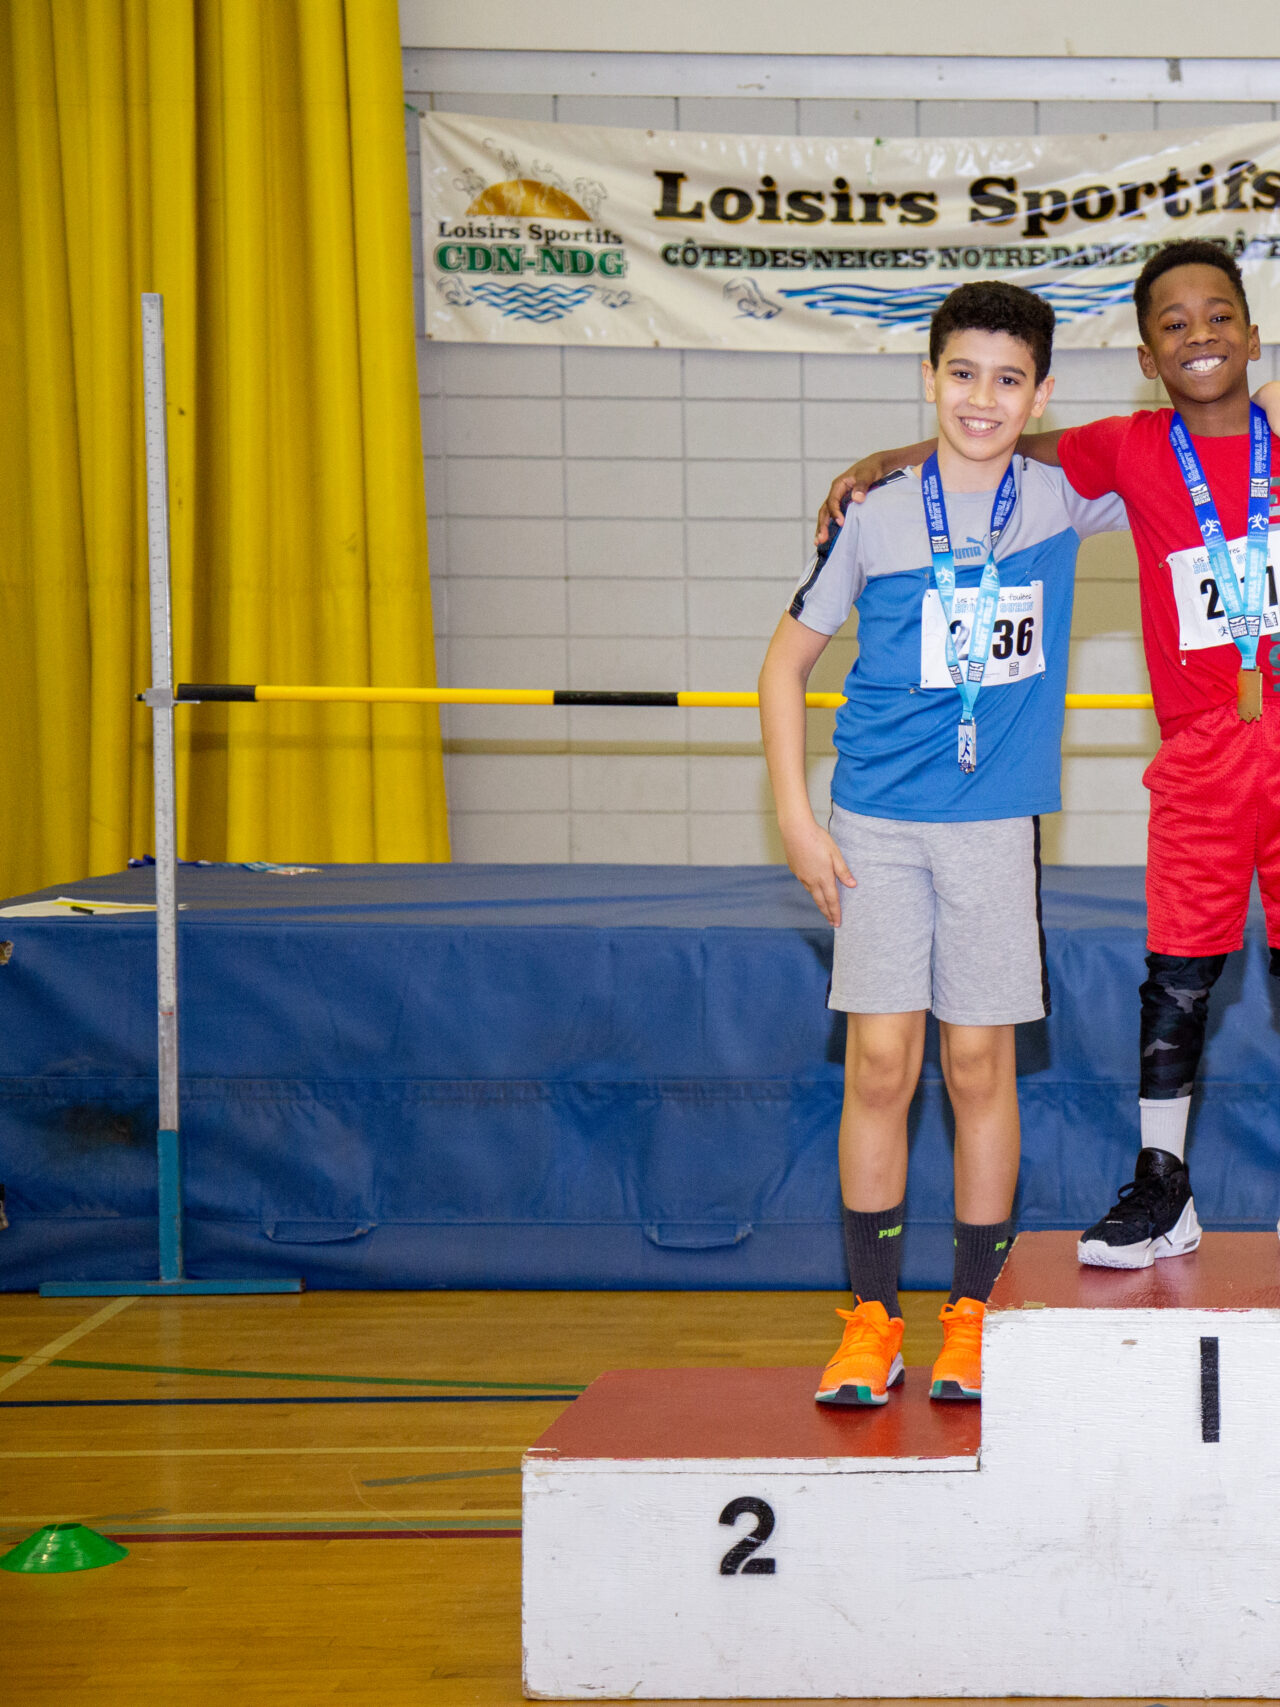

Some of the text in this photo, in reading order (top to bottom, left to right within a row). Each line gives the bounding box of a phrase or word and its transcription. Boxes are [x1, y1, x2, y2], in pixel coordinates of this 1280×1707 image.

[653, 170, 938, 226] Loisirs
[438, 221, 624, 245] Loisirs Sportifs
[436, 243, 628, 277] CDN-NDG
[953, 546, 981, 560] UMA
[950, 617, 1034, 660] 236
[718, 1496, 776, 1575] 2
